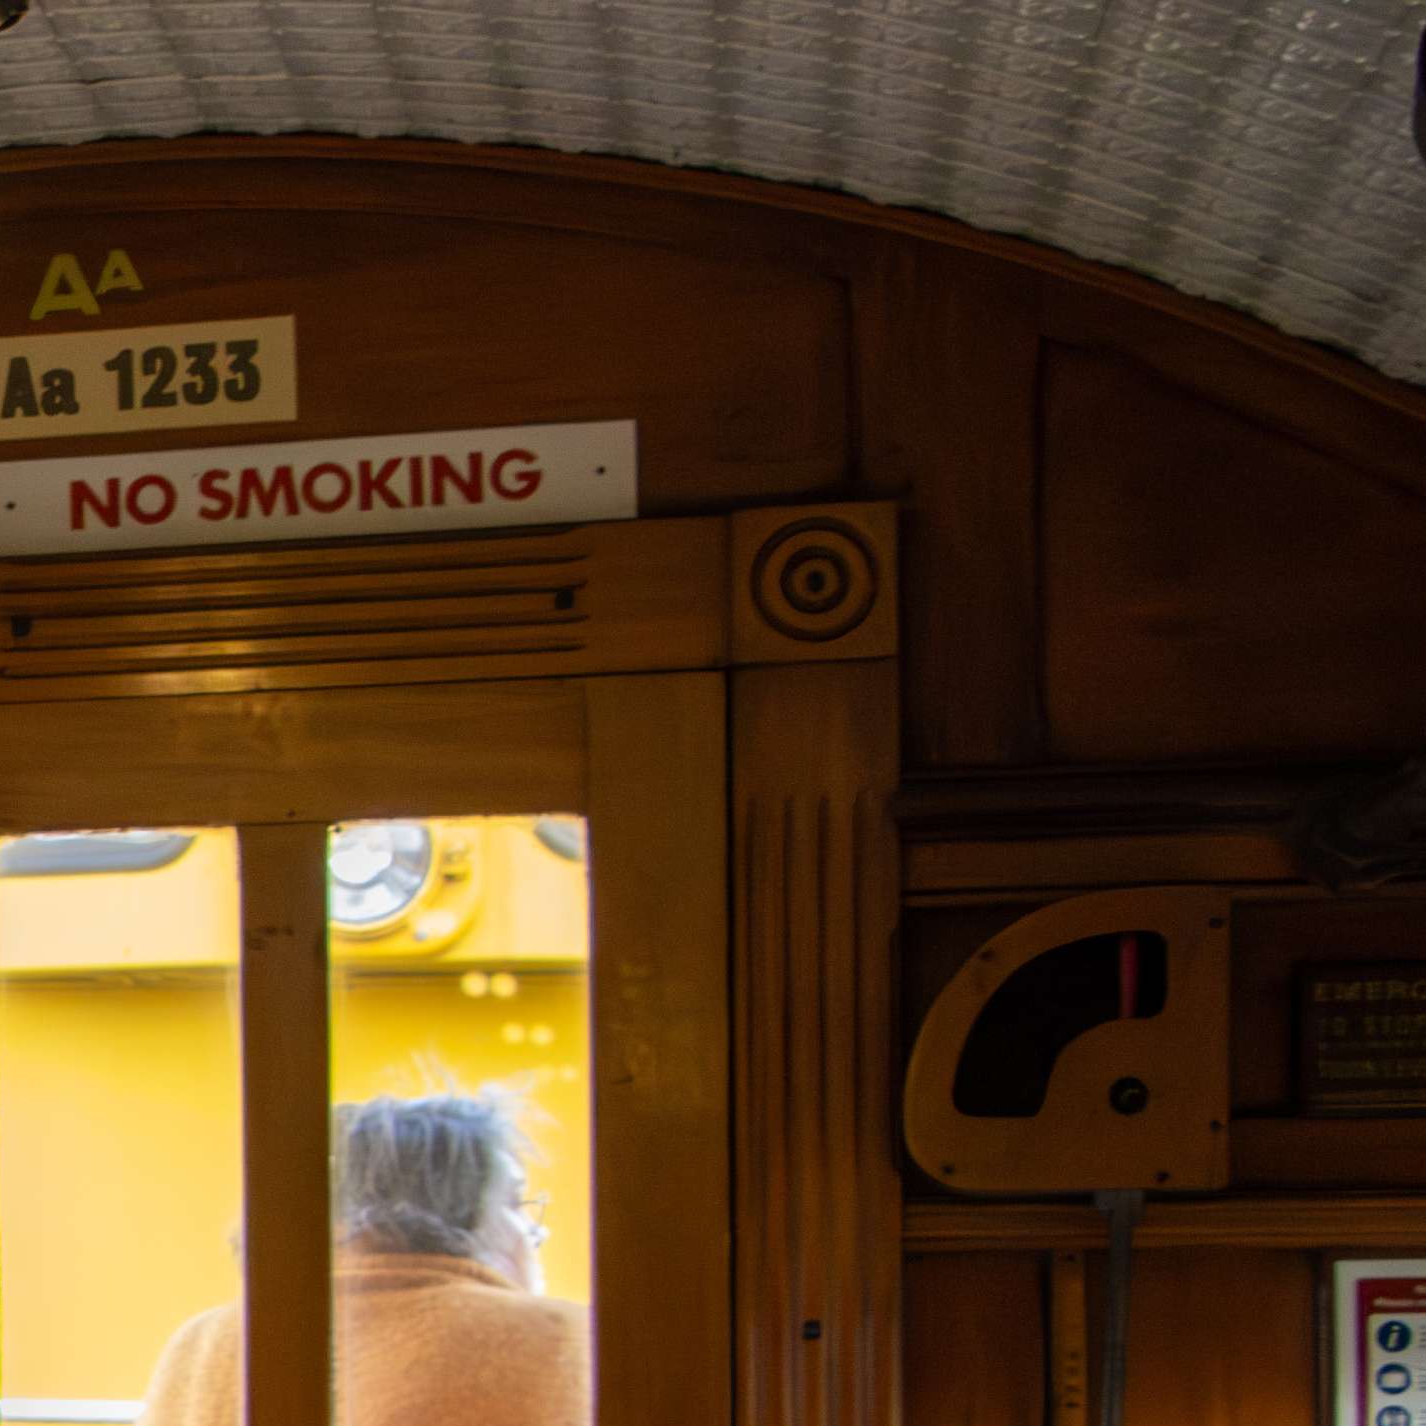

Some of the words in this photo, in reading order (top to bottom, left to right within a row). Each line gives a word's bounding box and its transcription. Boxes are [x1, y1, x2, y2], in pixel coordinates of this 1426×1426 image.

[0, 356, 80, 420] Aa
[103, 338, 262, 413] 1233
[68, 475, 177, 531] NO
[197, 448, 545, 522] SMOKING
